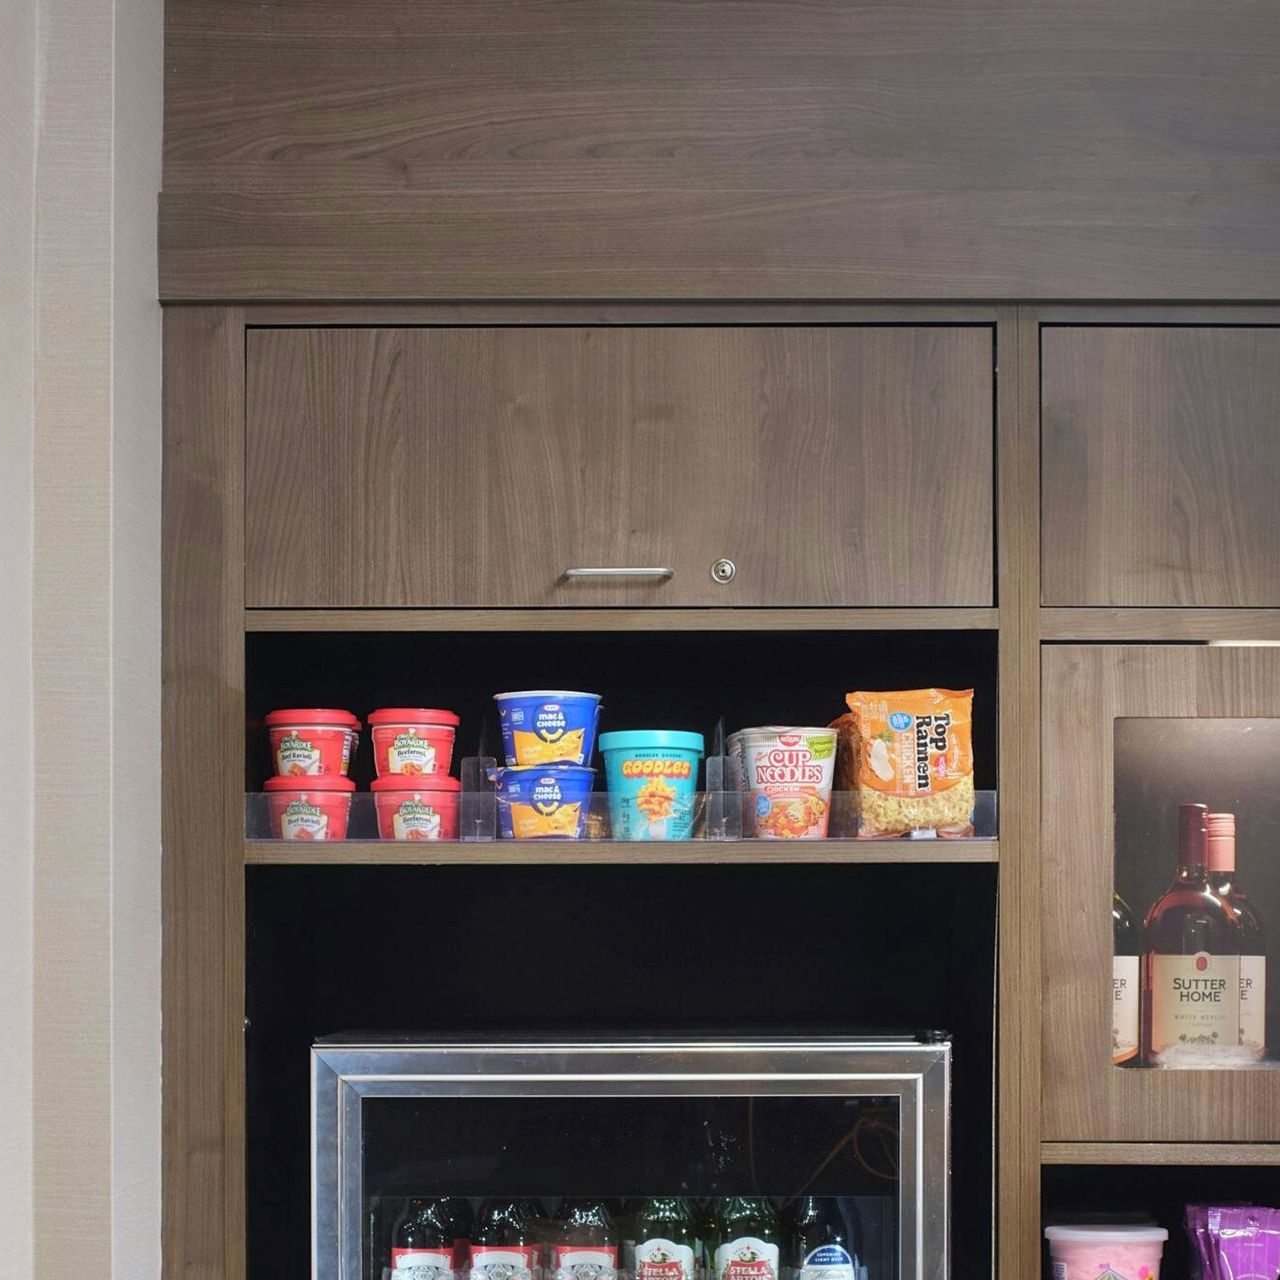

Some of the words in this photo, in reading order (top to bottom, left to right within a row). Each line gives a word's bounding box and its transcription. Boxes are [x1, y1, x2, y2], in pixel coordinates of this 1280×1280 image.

[929, 713, 951, 751] Top
[769, 750, 812, 767] CUP
[915, 715, 931, 789] Ramen
[621, 760, 690, 779] GOODLES
[756, 765, 822, 784] NOODLES
[1173, 977, 1227, 990] SUTTER
[1180, 991, 1221, 1002] HOME
[642, 1267, 679, 1277] STELLA
[729, 1266, 768, 1276] STELLA
